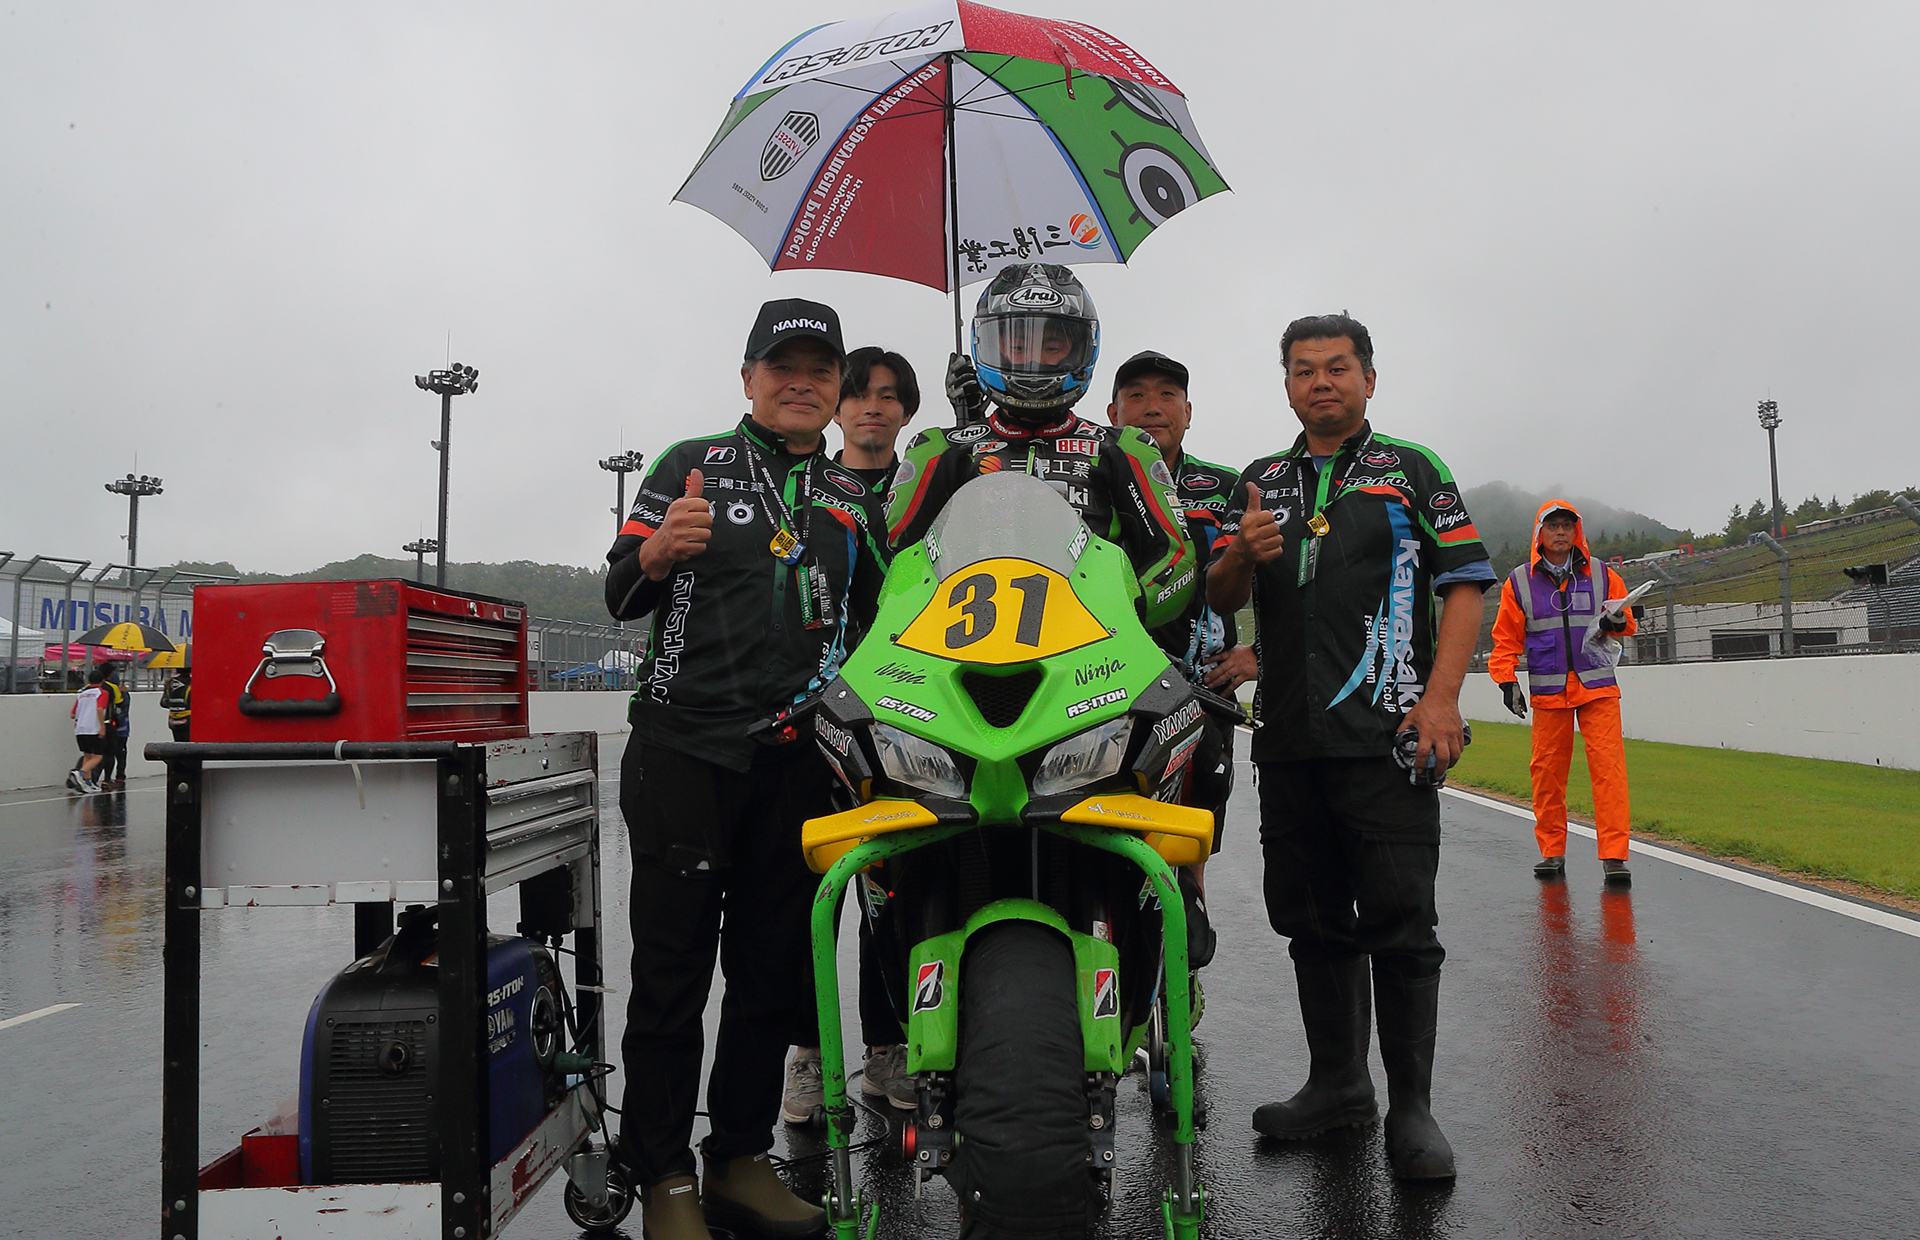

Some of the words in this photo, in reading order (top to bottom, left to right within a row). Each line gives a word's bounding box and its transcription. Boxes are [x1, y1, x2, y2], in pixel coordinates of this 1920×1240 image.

[763, 20, 954, 85] RS-ITOH
[1115, 47, 1170, 86] Project
[1011, 288, 1056, 302] Arai
[772, 318, 828, 334] NANKAI
[950, 425, 983, 439] Arai
[1058, 439, 1096, 455] BEET
[1180, 499, 1226, 513] S-ITOH
[1434, 509, 1468, 529] Ninja
[1068, 526, 1089, 561] WRS
[1156, 568, 1195, 605] RS-ITOH
[944, 572, 1050, 649] 31
[1393, 538, 1425, 713] Kawasaki
[1364, 615, 1376, 684] rs-itoh.com
[874, 662, 927, 684] Ninja
[1075, 657, 1127, 687] Ninja
[875, 696, 938, 722] RS-ITOH
[1066, 689, 1128, 718] RS-ITOH
[1153, 700, 1202, 745] NANKA
